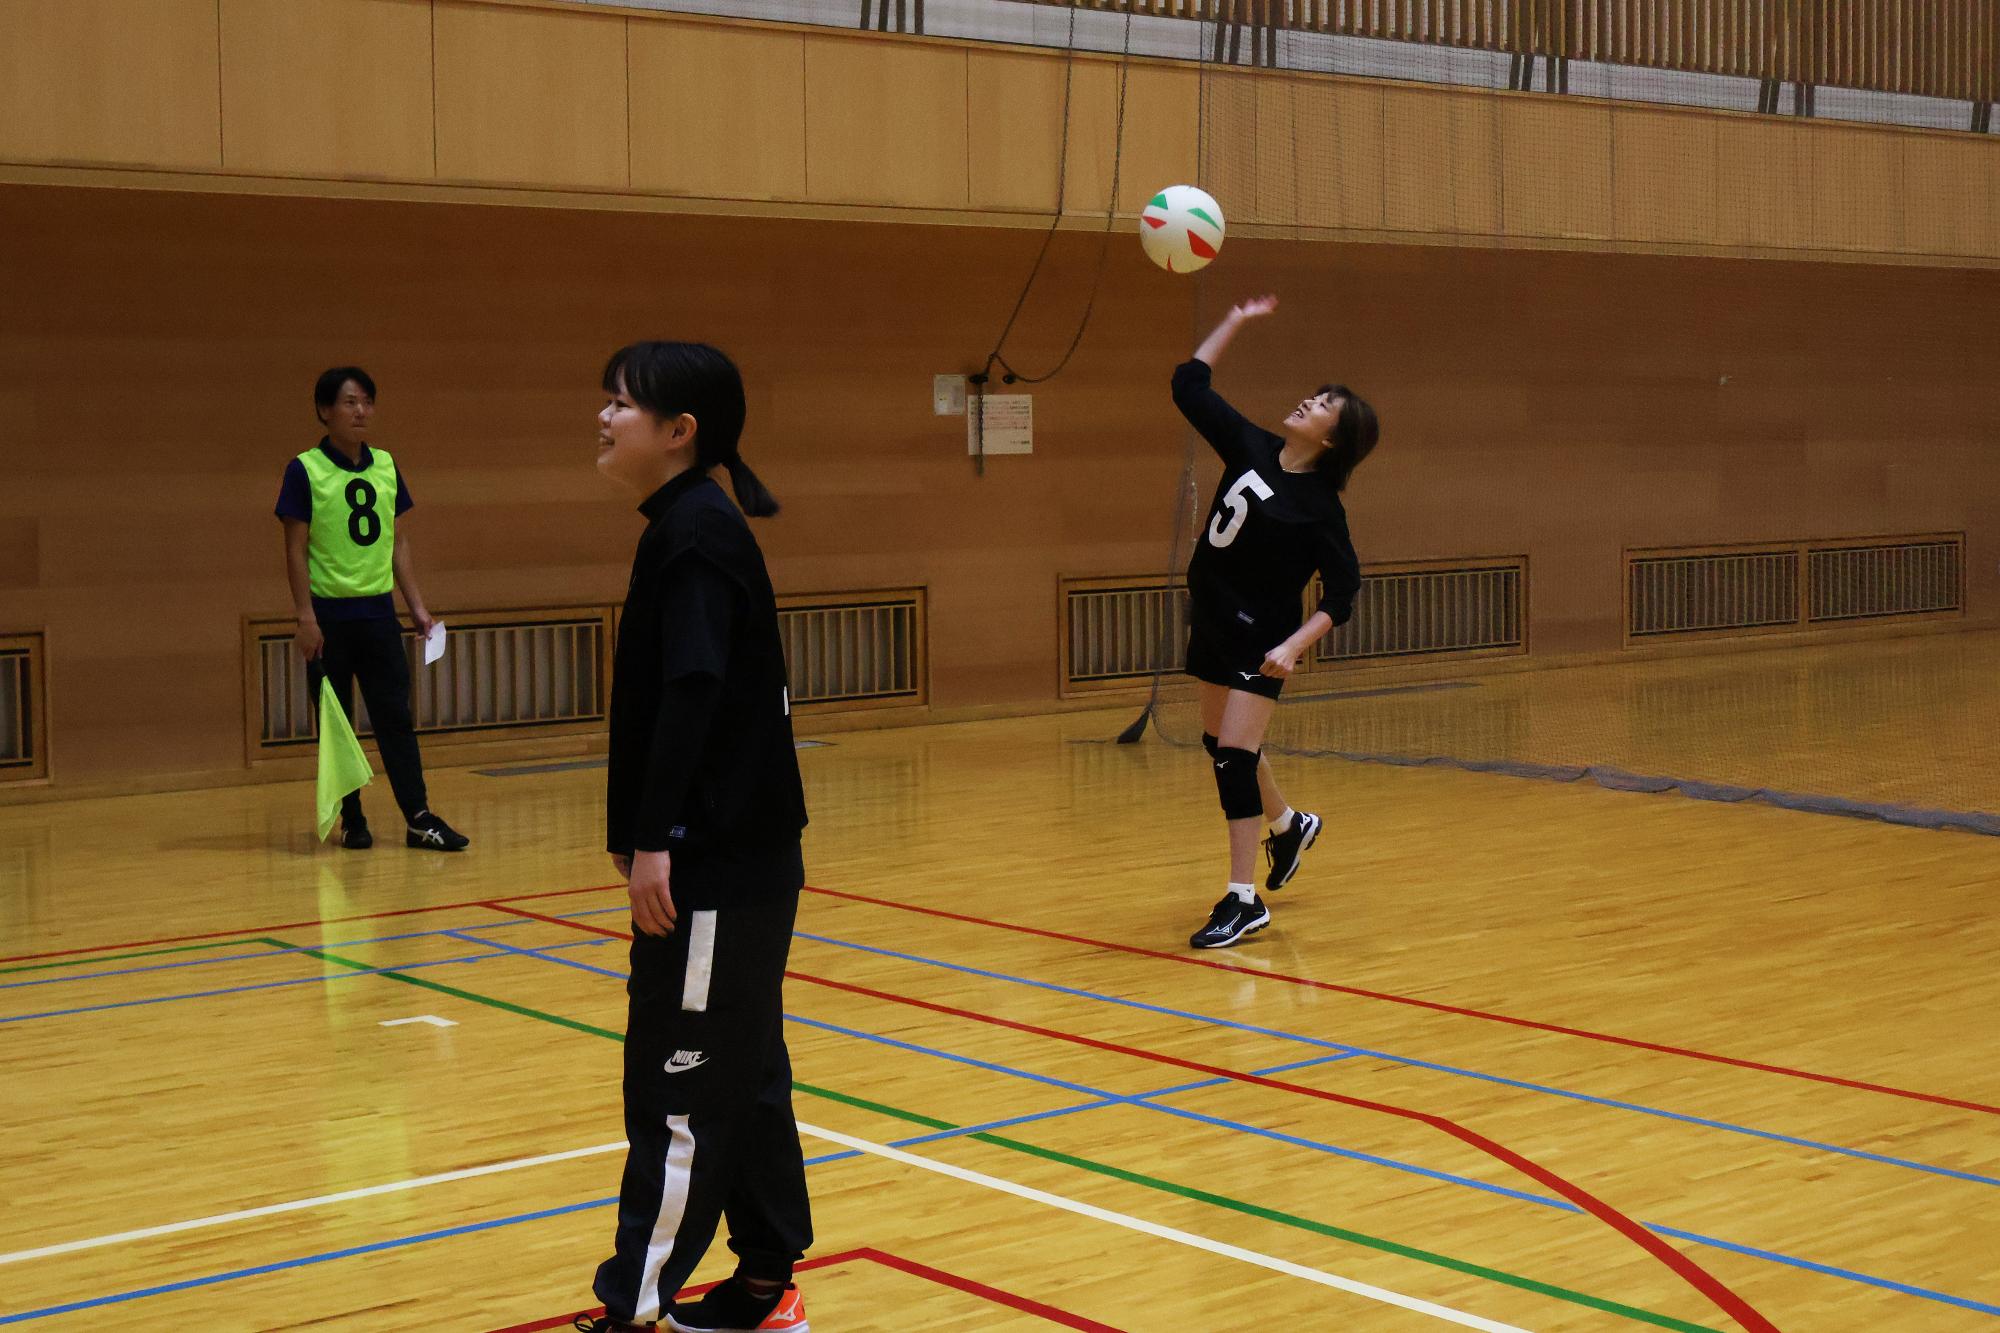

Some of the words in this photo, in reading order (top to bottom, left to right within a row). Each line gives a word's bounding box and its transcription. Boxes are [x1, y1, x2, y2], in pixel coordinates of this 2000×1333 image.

[345, 478, 381, 546] 8
[1209, 469, 1274, 548] 5
[671, 1049, 703, 1065] NIKE
